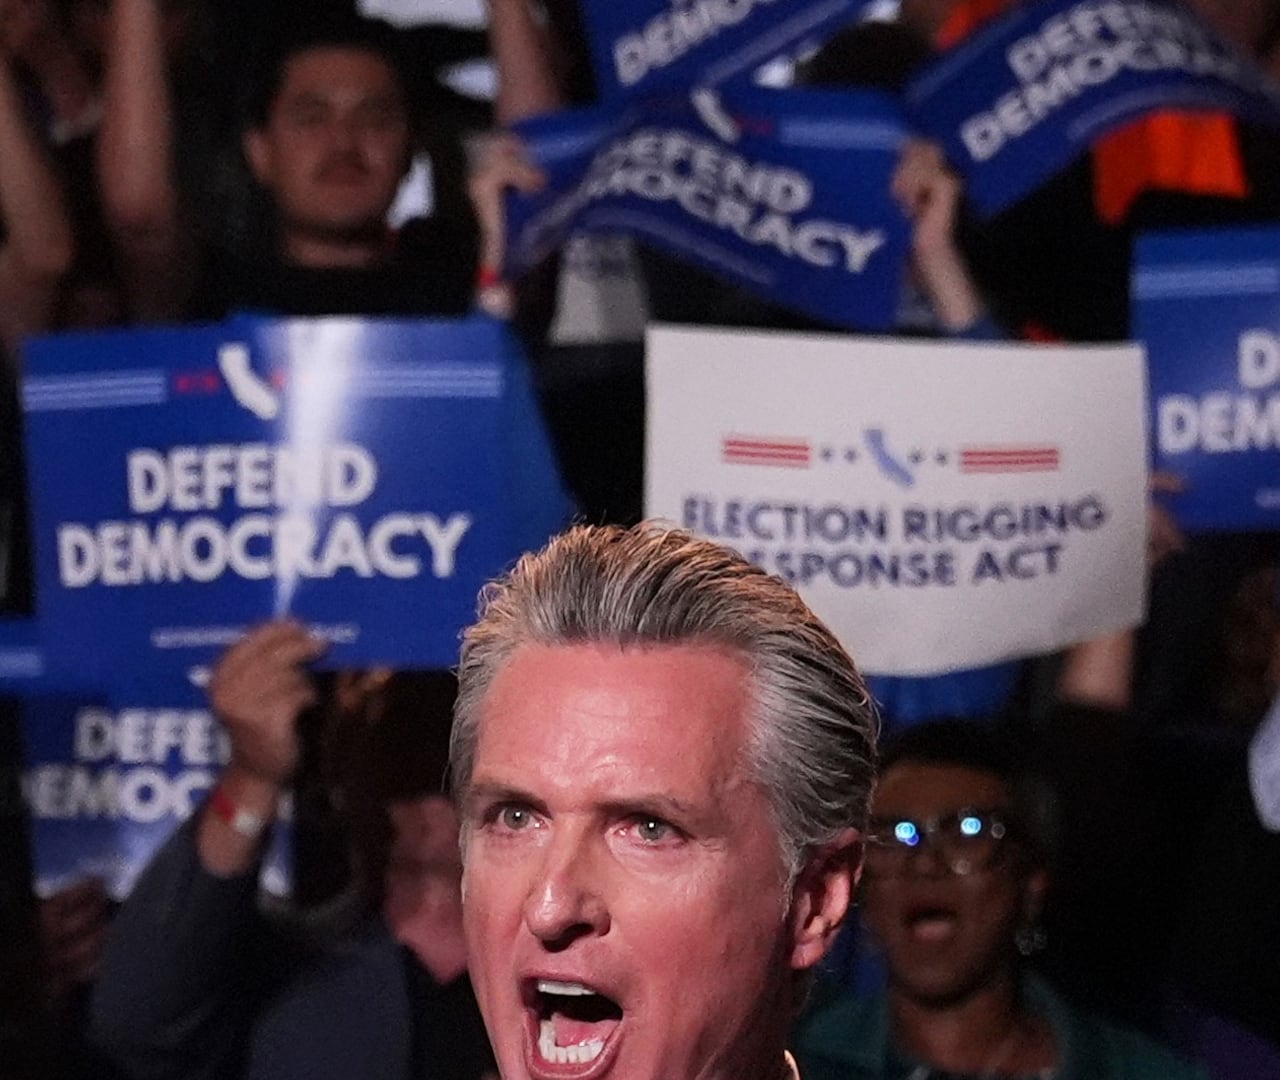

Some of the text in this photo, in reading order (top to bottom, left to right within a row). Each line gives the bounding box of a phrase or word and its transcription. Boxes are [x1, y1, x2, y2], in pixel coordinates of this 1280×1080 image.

[682, 494, 1106, 543] ELECTION RIGGING
[56, 511, 472, 588] DEMOCRACY
[749, 543, 1062, 588] SPONSE ACT
